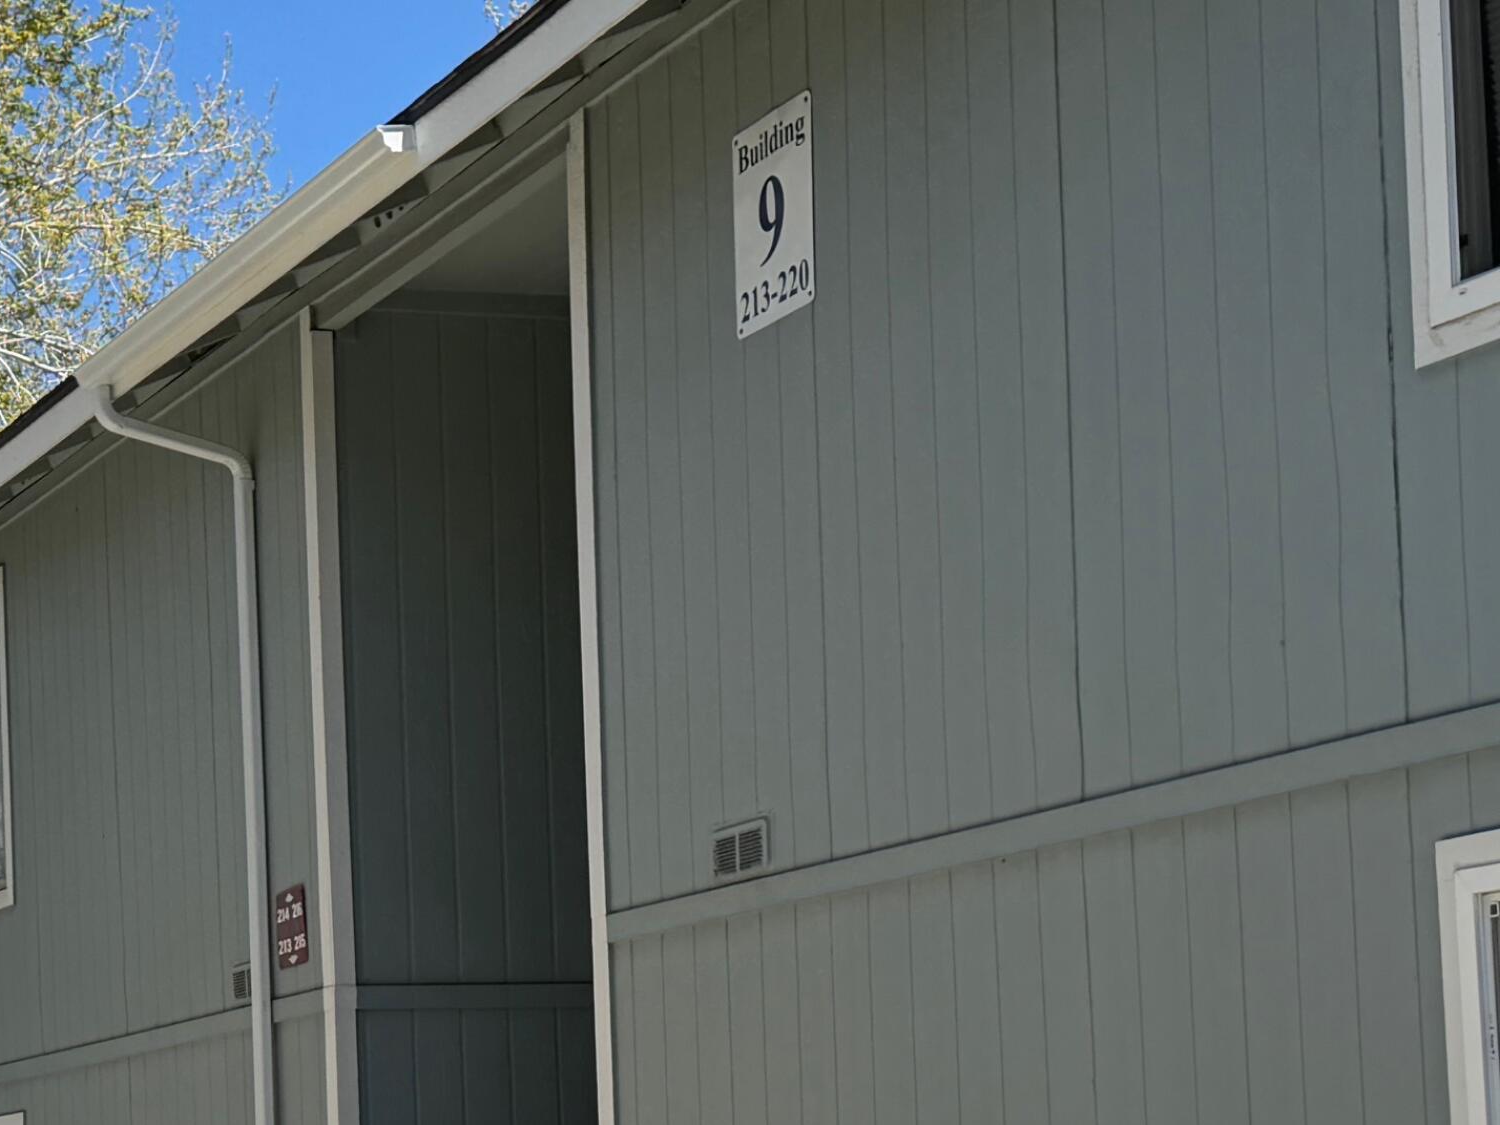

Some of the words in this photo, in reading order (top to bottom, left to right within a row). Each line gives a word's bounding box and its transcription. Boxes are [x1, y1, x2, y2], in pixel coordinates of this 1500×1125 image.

[738, 115, 805, 175] Building
[759, 175, 785, 268] 9
[741, 258, 809, 324] 213-220
[277, 907, 290, 923] 214
[278, 938, 292, 955] 213
